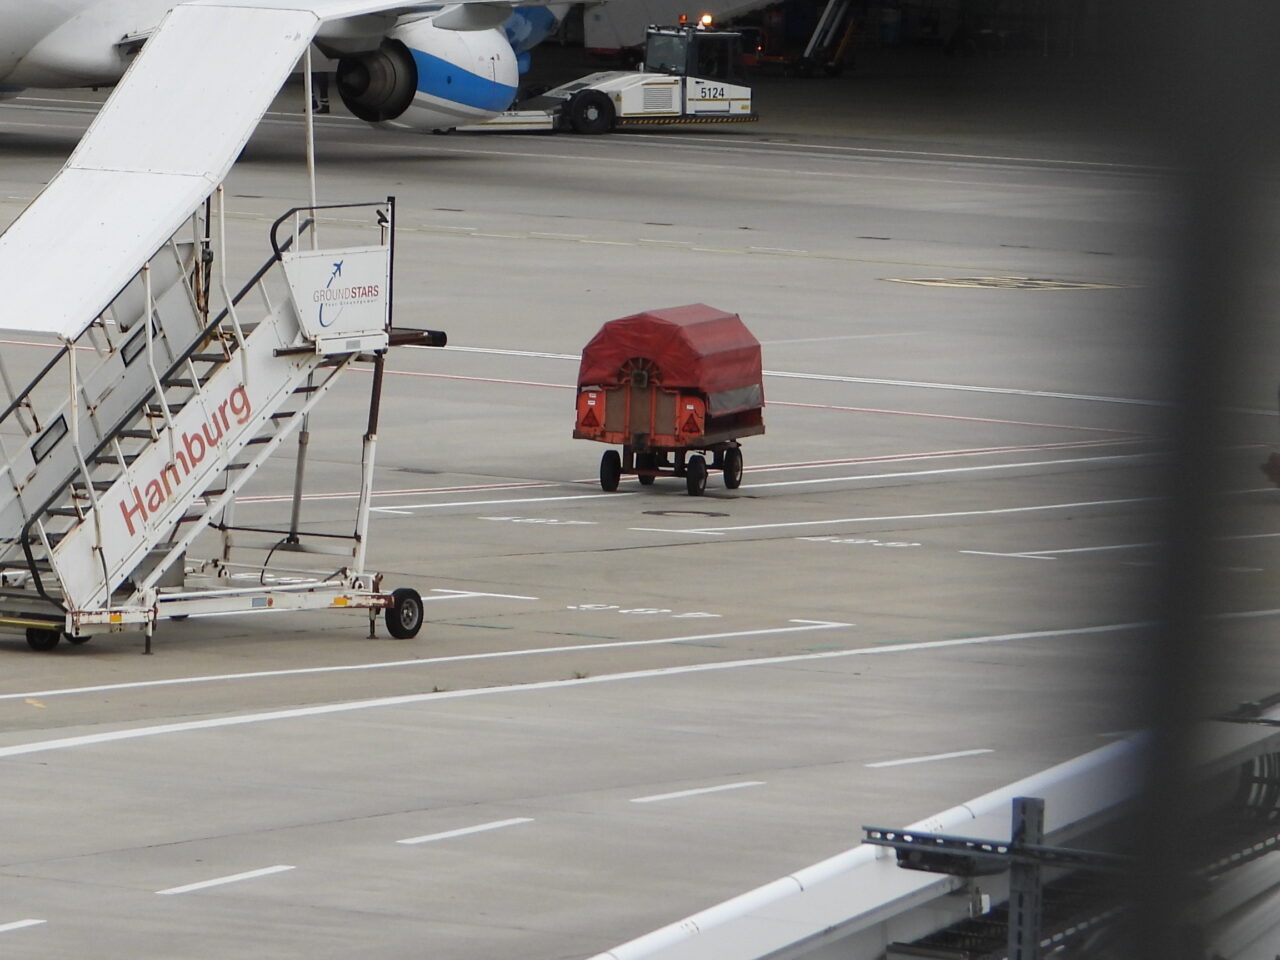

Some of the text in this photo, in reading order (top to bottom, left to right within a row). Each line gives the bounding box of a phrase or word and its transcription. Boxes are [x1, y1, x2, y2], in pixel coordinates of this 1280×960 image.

[700, 87, 725, 99] 5124
[313, 284, 379, 303] GROUNDSTARS
[119, 386, 252, 537] Hamburg
